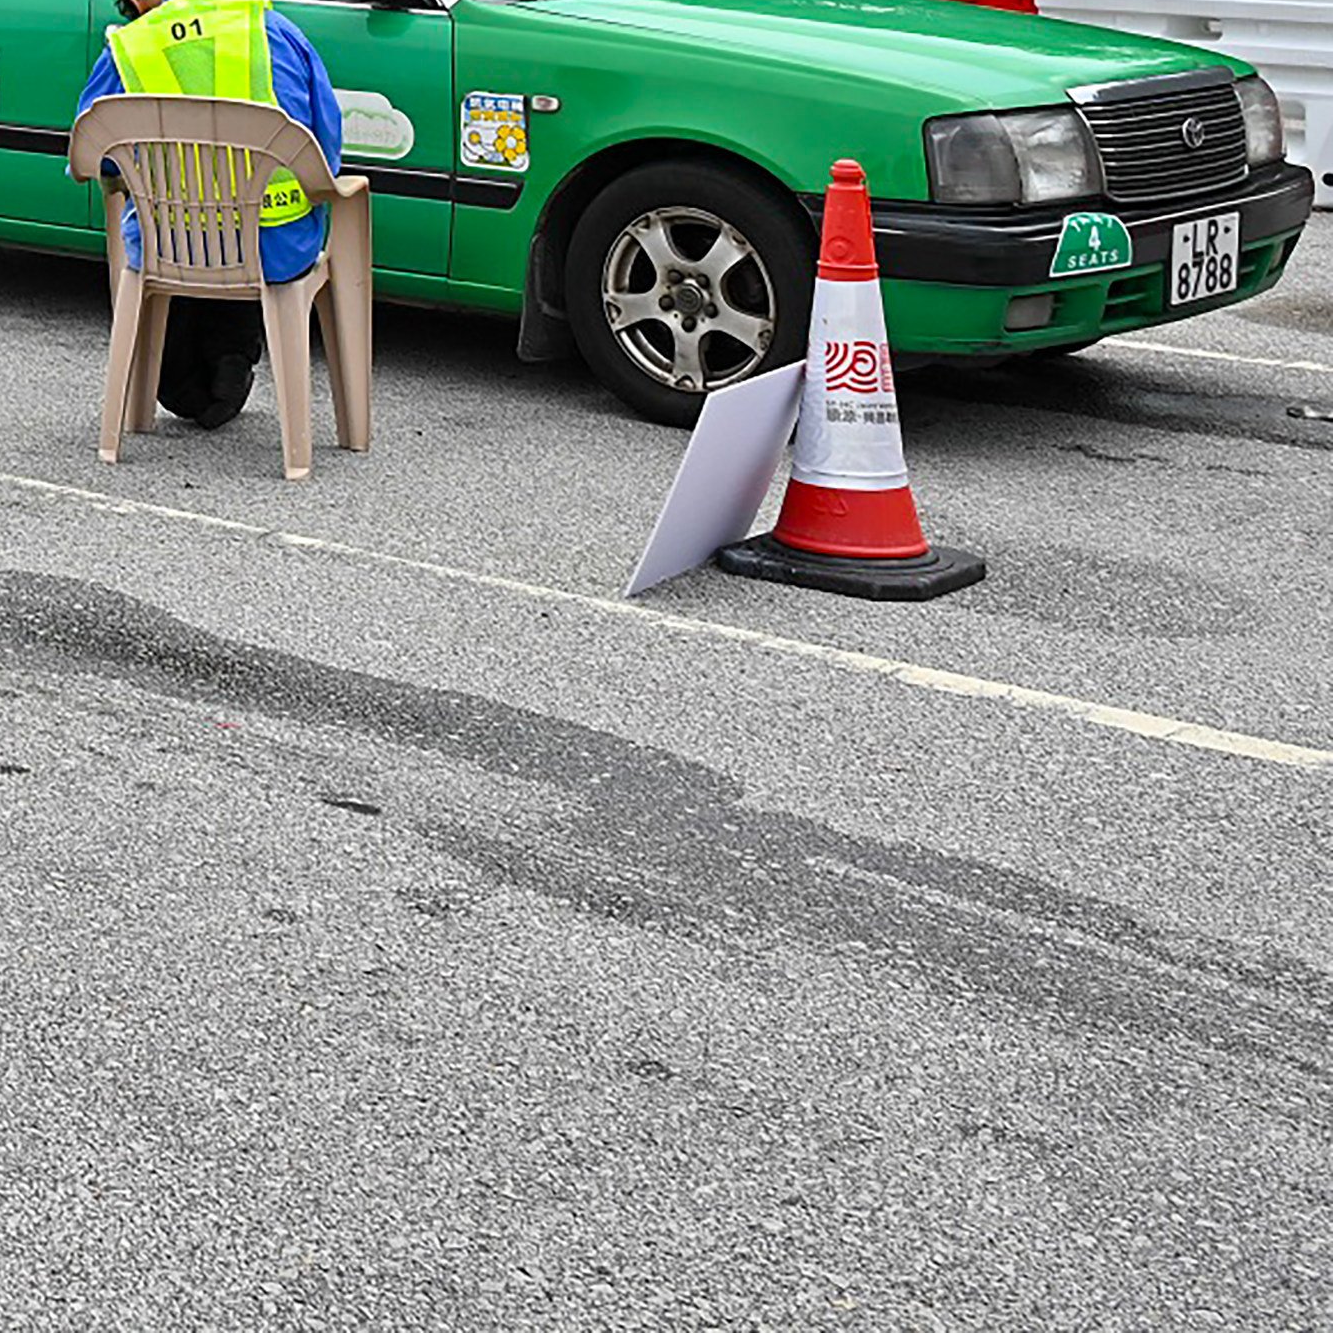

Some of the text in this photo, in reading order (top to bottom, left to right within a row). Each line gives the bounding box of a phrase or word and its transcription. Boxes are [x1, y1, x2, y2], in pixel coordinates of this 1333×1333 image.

[171, 18, 202, 41] 01
[1088, 225, 1101, 251] 4
[1192, 219, 1219, 259] LR
[1067, 249, 1119, 269] SEATS
[1177, 253, 1233, 300] 8788
